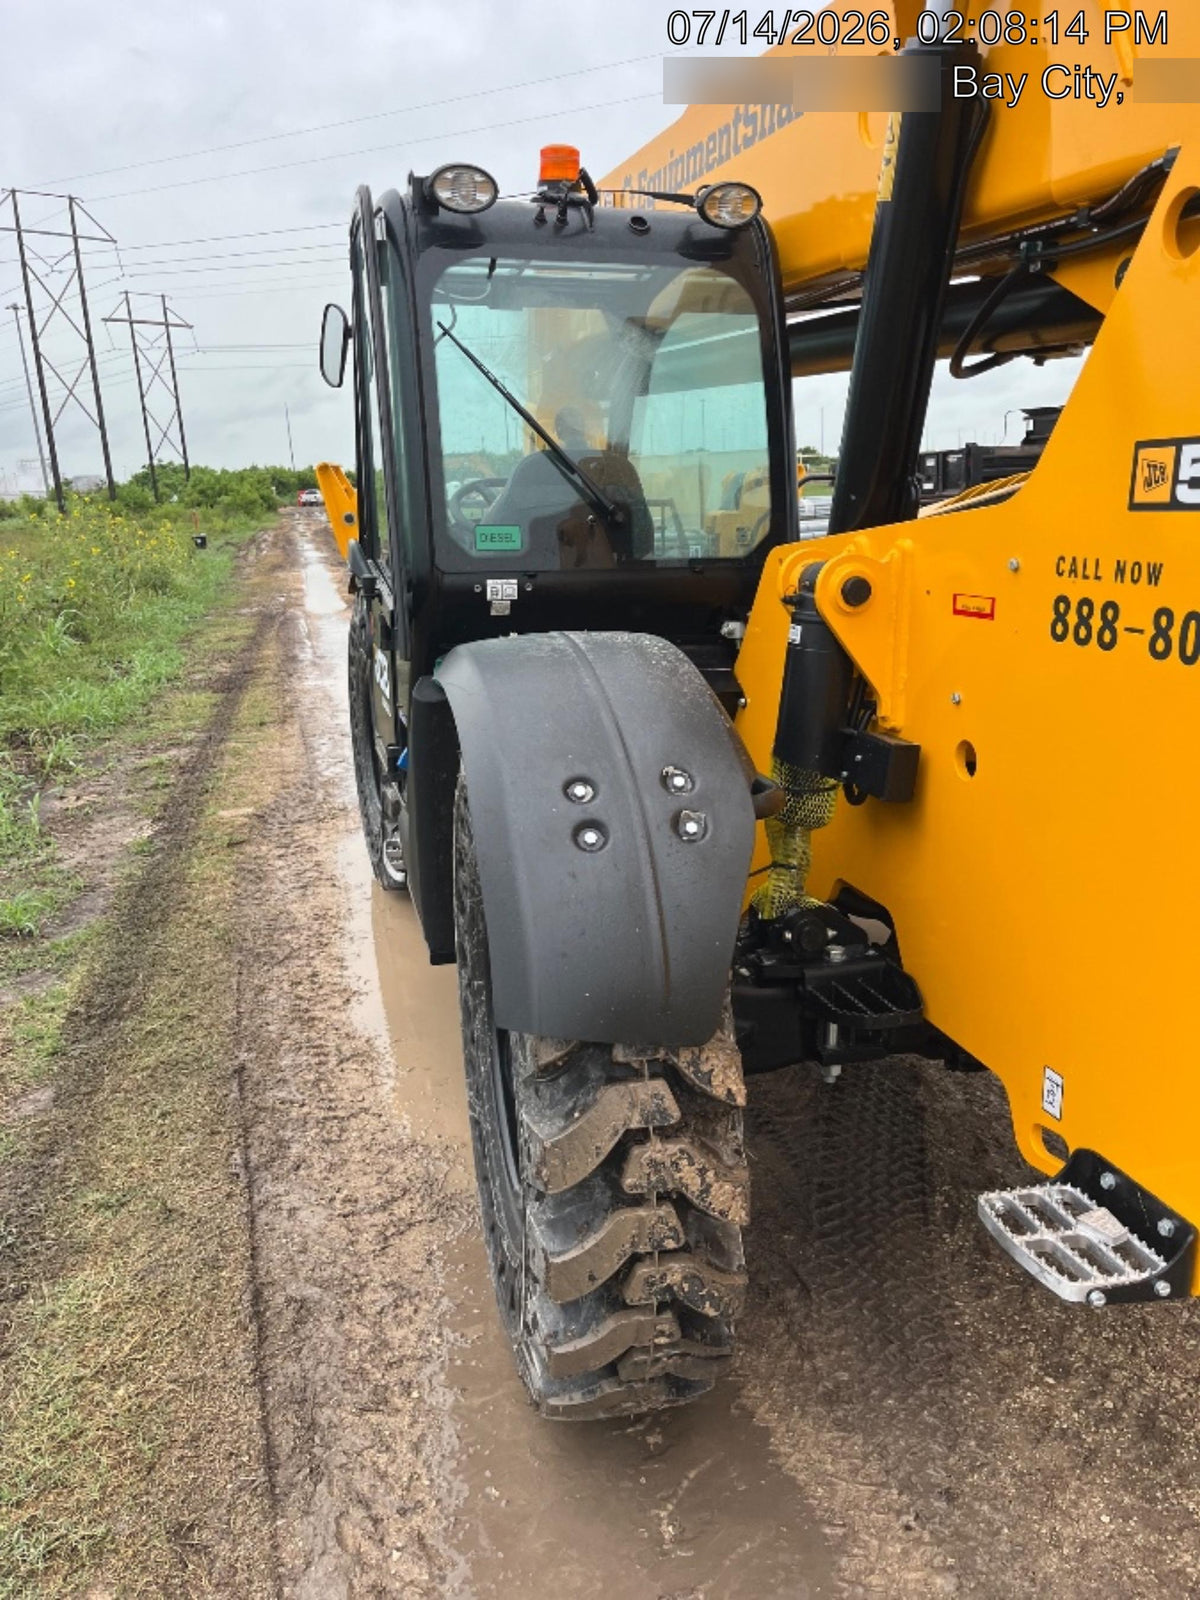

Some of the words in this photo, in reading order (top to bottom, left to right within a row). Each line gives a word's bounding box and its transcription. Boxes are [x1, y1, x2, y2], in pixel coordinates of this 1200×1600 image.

[1142, 459, 1168, 491] JCB
[479, 532, 516, 544] DIESEL
[1055, 555, 1102, 581] CALL
[1114, 559, 1163, 587] NOW
[1050, 594, 1200, 666] 888-80
